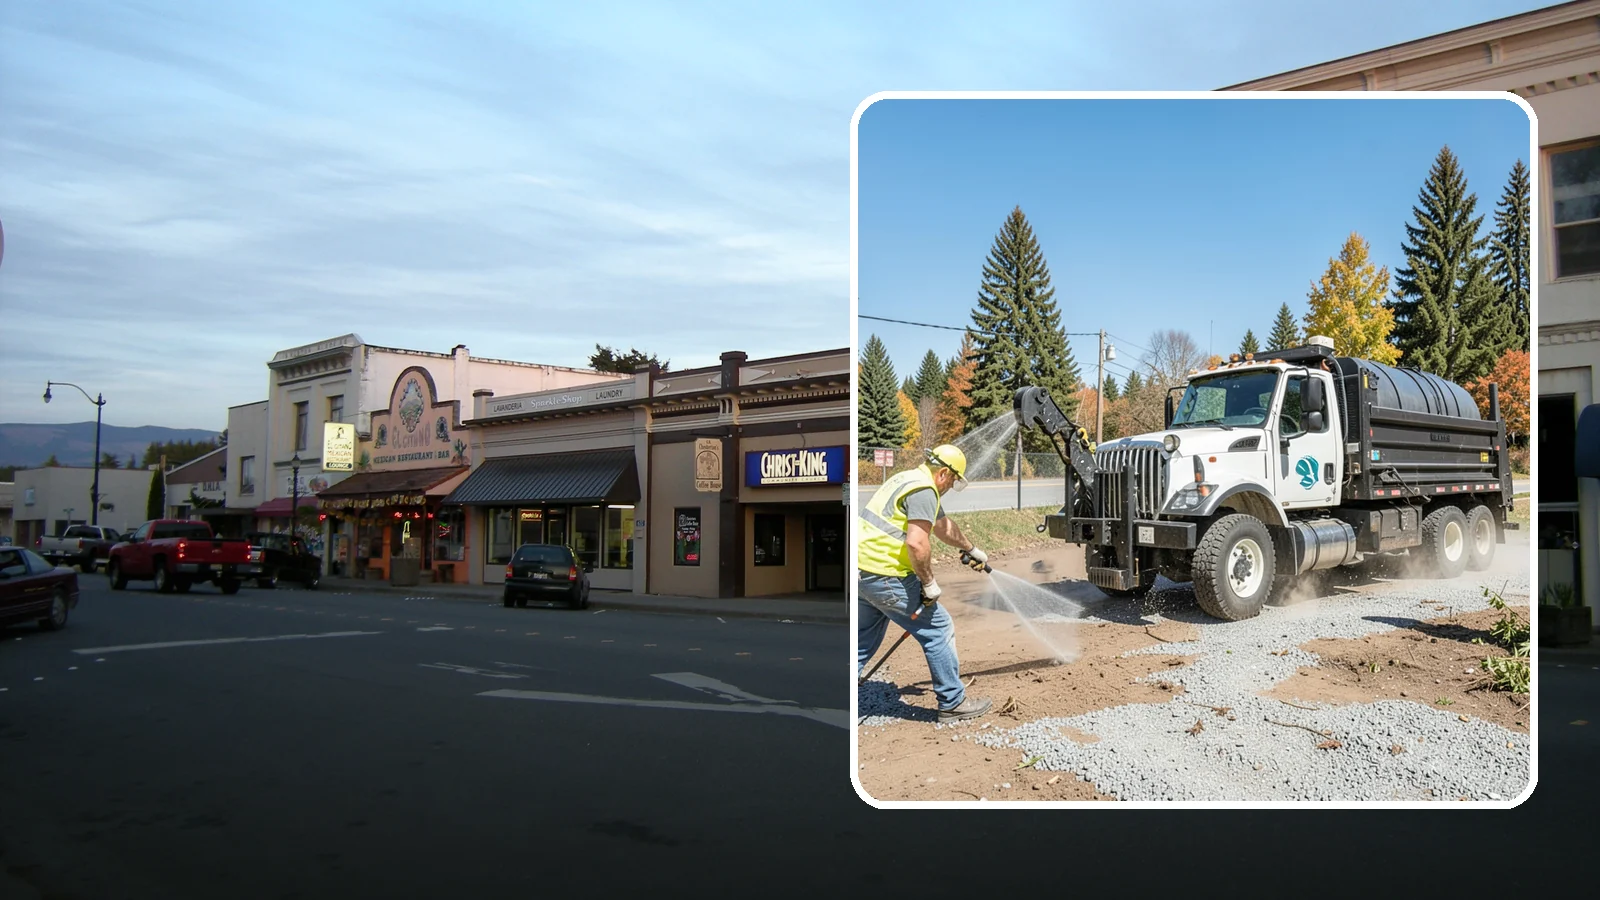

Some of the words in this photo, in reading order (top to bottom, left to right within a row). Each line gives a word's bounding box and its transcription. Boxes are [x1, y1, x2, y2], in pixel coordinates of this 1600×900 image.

[493, 402, 523, 413] LAVANDERIA
[595, 389, 623, 400] LAUNDRY
[397, 451, 434, 462] RESTAURANT
[437, 450, 450, 459] BAR
[761, 452, 797, 478] CHRIST
[799, 450, 828, 476] KING
